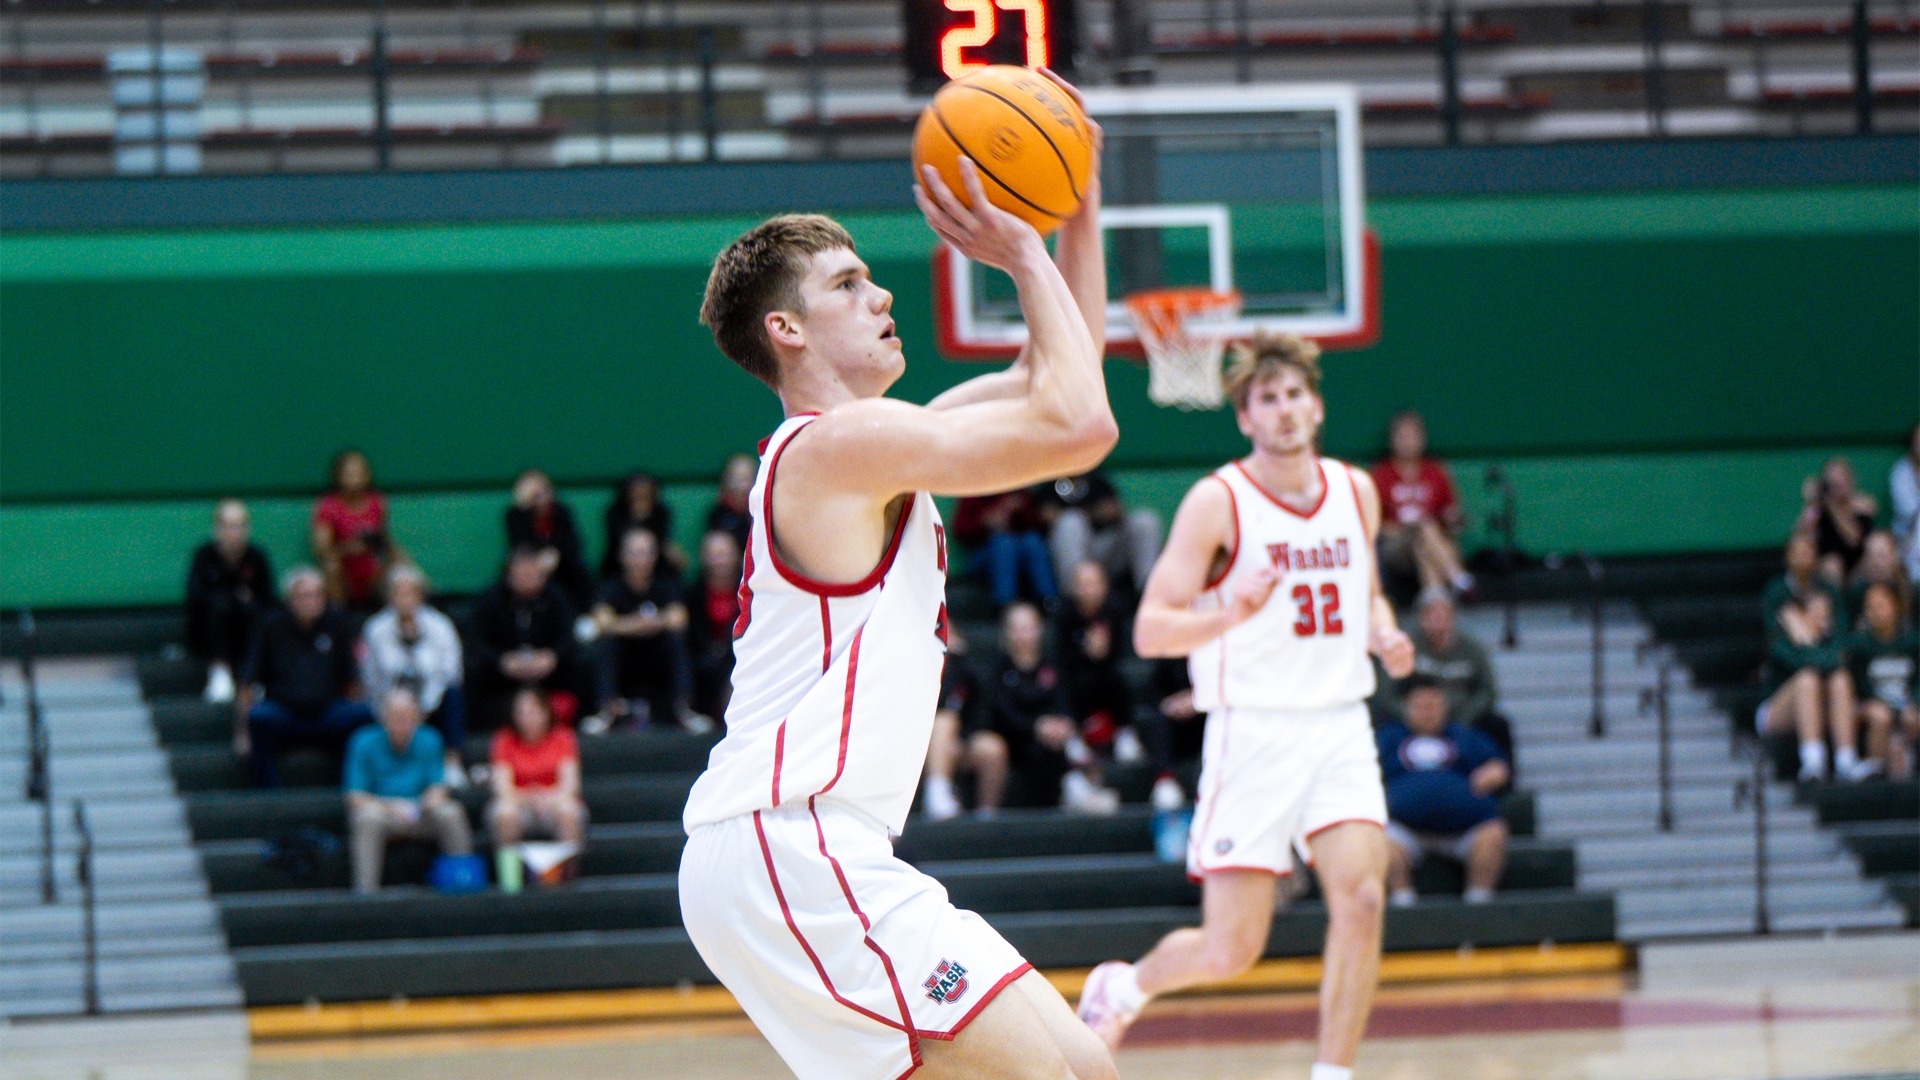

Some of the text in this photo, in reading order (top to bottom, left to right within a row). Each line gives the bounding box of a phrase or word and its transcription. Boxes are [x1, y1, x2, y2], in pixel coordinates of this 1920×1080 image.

[941, 0, 1048, 80] 27
[1267, 537, 1350, 572] WashU
[1291, 583, 1344, 637] 32
[928, 961, 967, 1003] WASH
